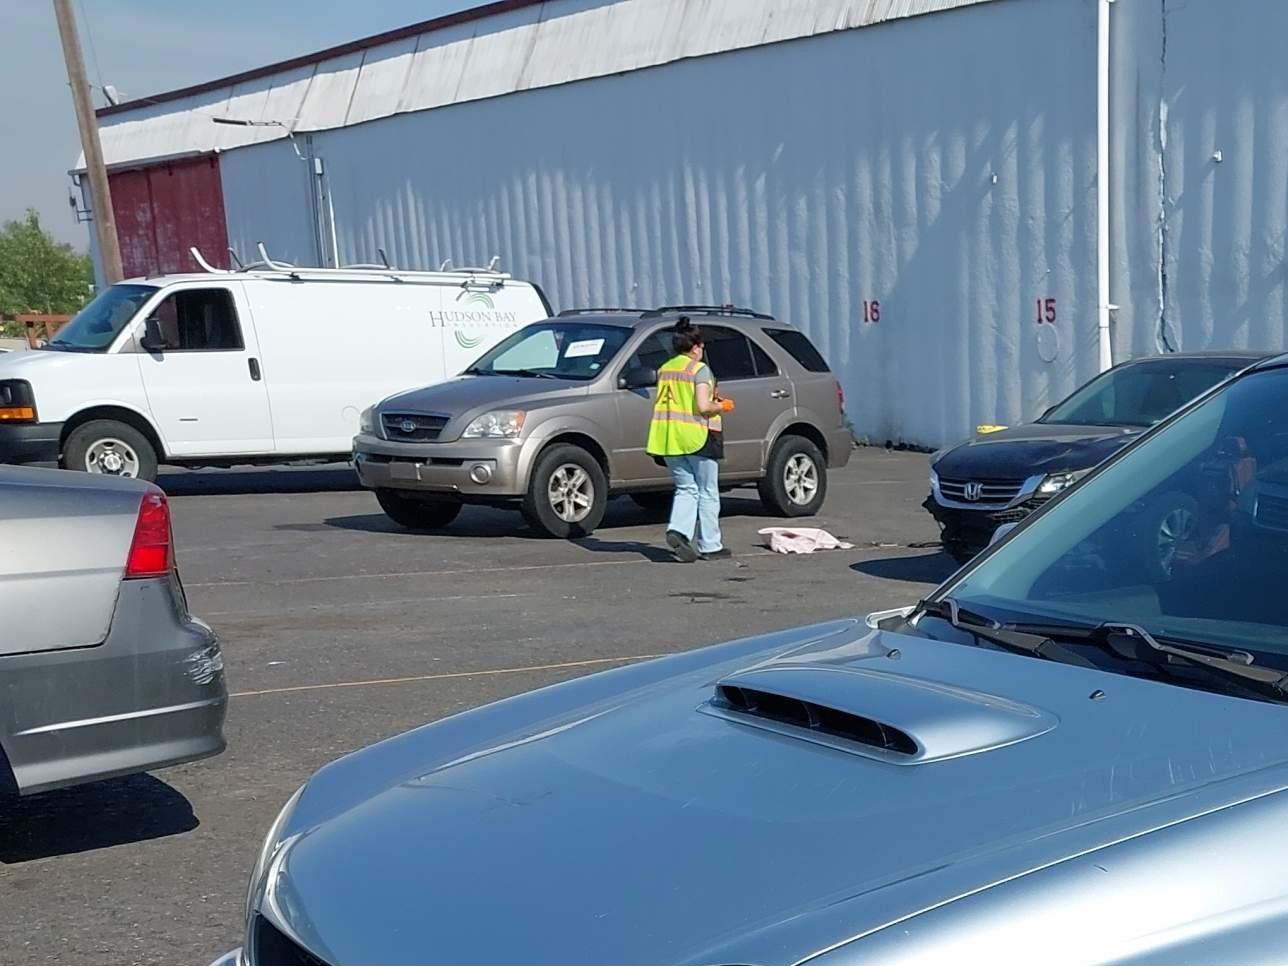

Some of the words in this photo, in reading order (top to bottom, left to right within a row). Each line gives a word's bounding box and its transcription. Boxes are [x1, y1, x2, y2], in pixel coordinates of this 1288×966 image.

[494, 311, 517, 322] BAY
[863, 300, 880, 323] 16
[1036, 298, 1056, 324] 15
